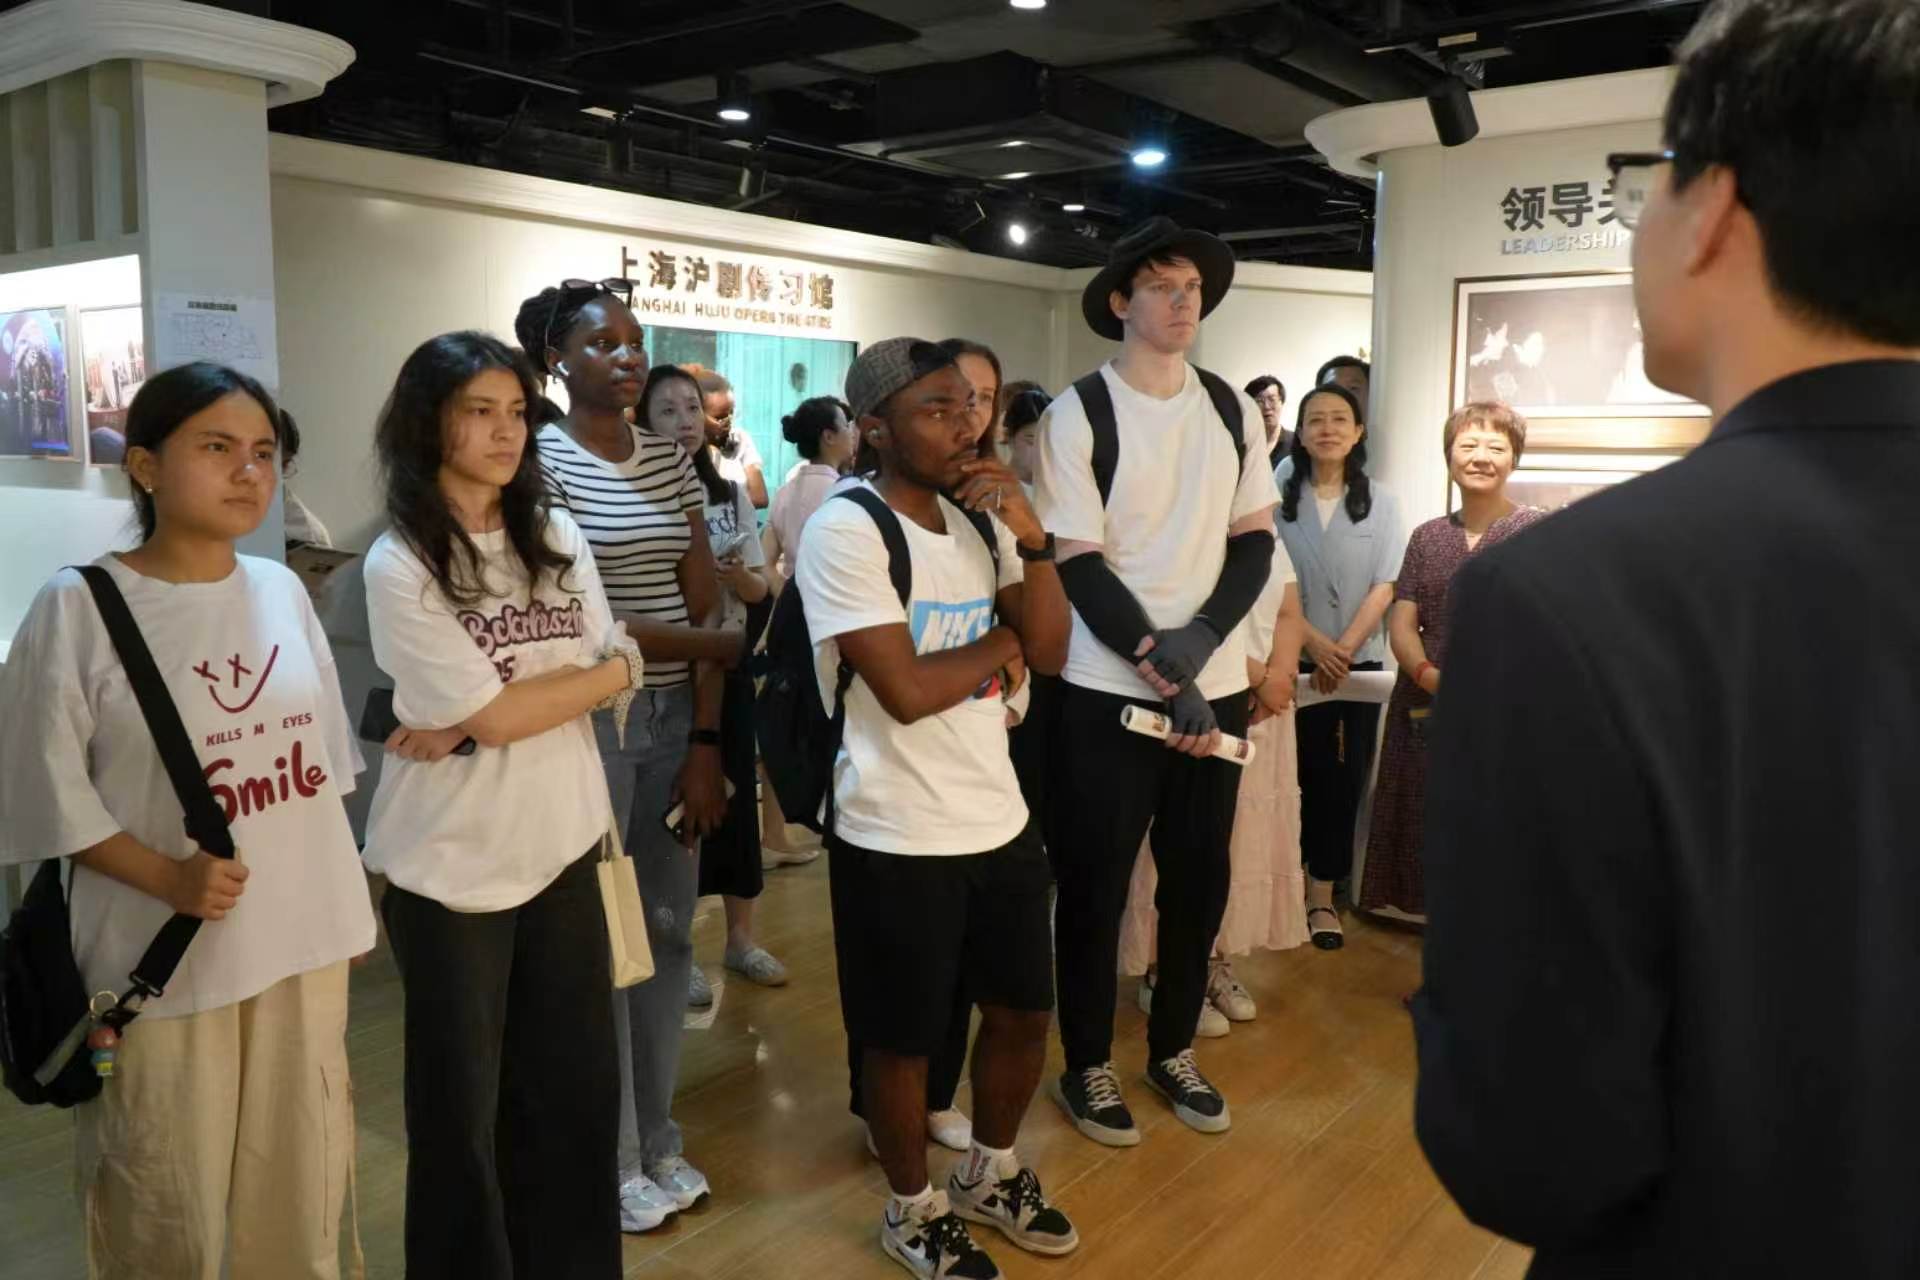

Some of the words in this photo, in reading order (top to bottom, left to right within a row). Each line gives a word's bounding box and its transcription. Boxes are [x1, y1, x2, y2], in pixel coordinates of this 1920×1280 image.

[1501, 231, 1630, 256] LEADERSHIP
[630, 295, 687, 315] ANGHAI
[734, 307, 777, 324] OPERA
[205, 727, 243, 747] KILLS
[282, 712, 313, 730] EYES
[202, 740, 327, 826] Smile
